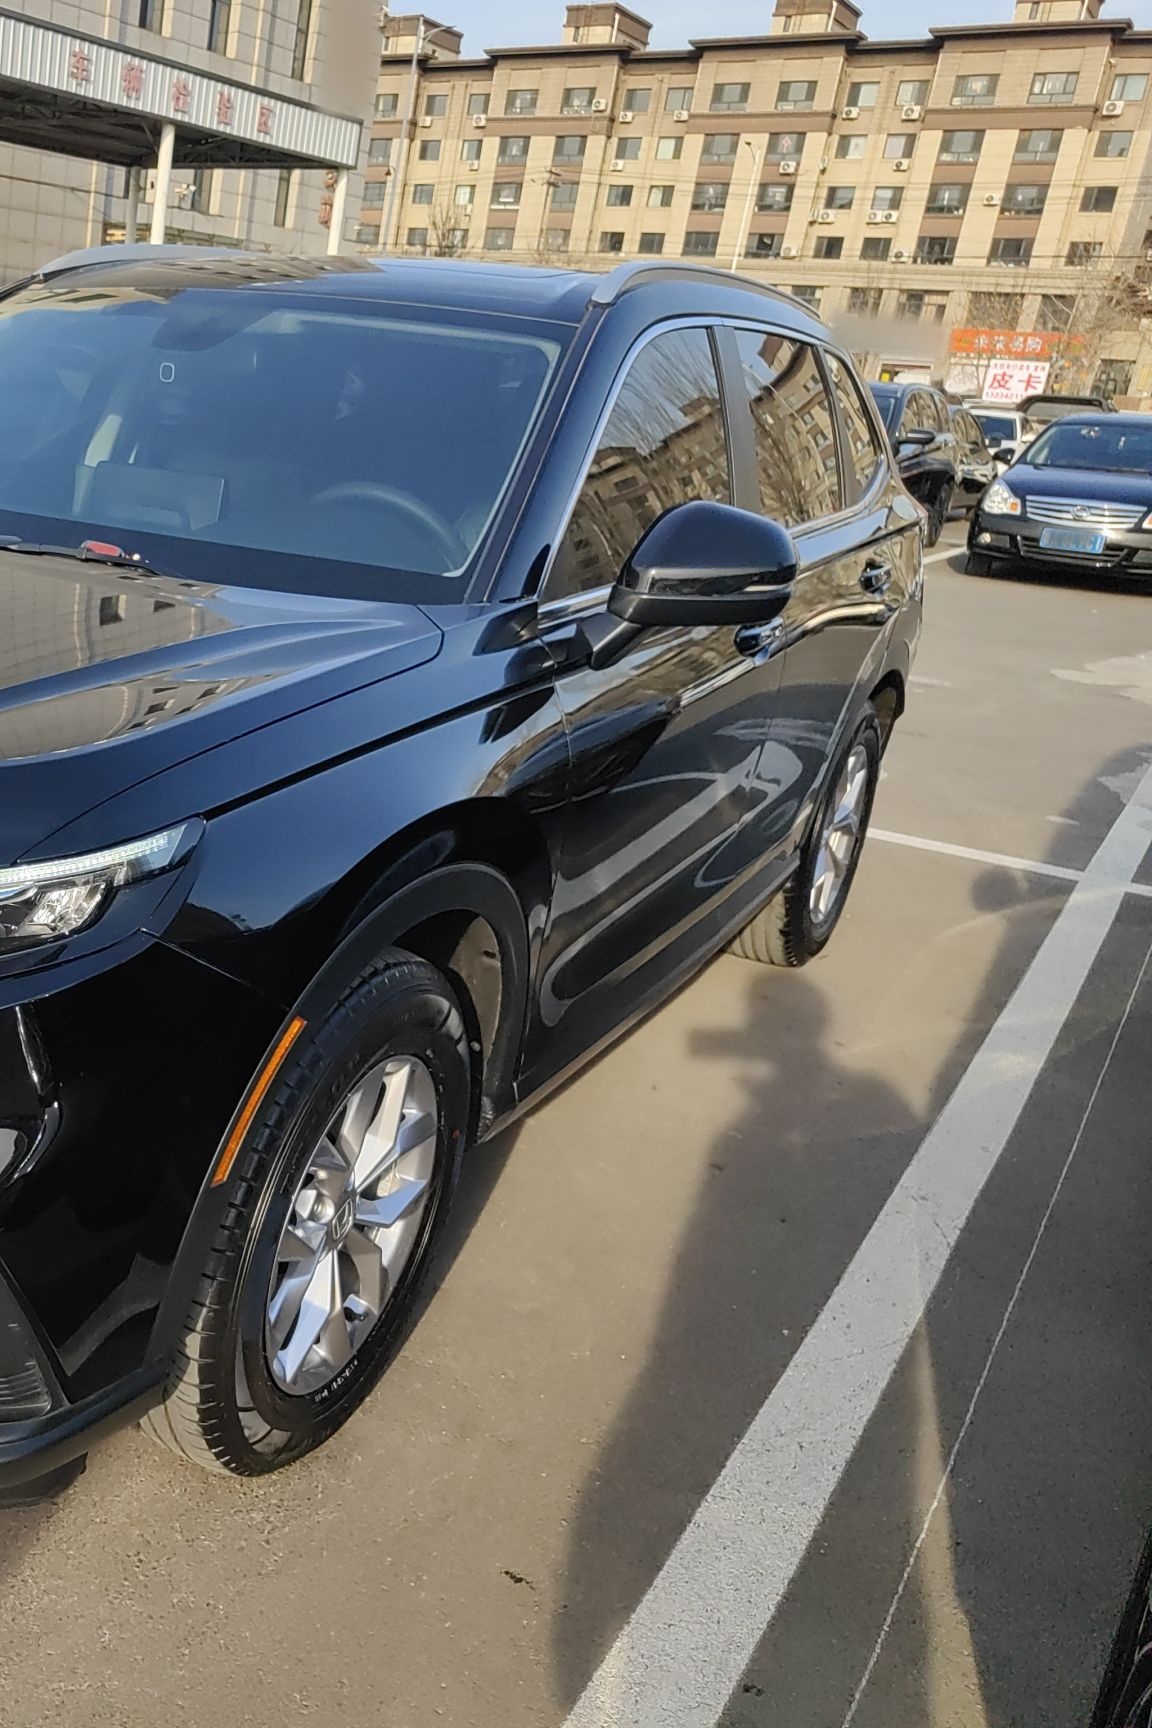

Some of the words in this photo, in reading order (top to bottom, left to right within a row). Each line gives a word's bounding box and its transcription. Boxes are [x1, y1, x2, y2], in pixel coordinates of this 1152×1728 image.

[71, 49, 274, 134] 车辆检验区
[988, 371, 1043, 392] 皮卡
